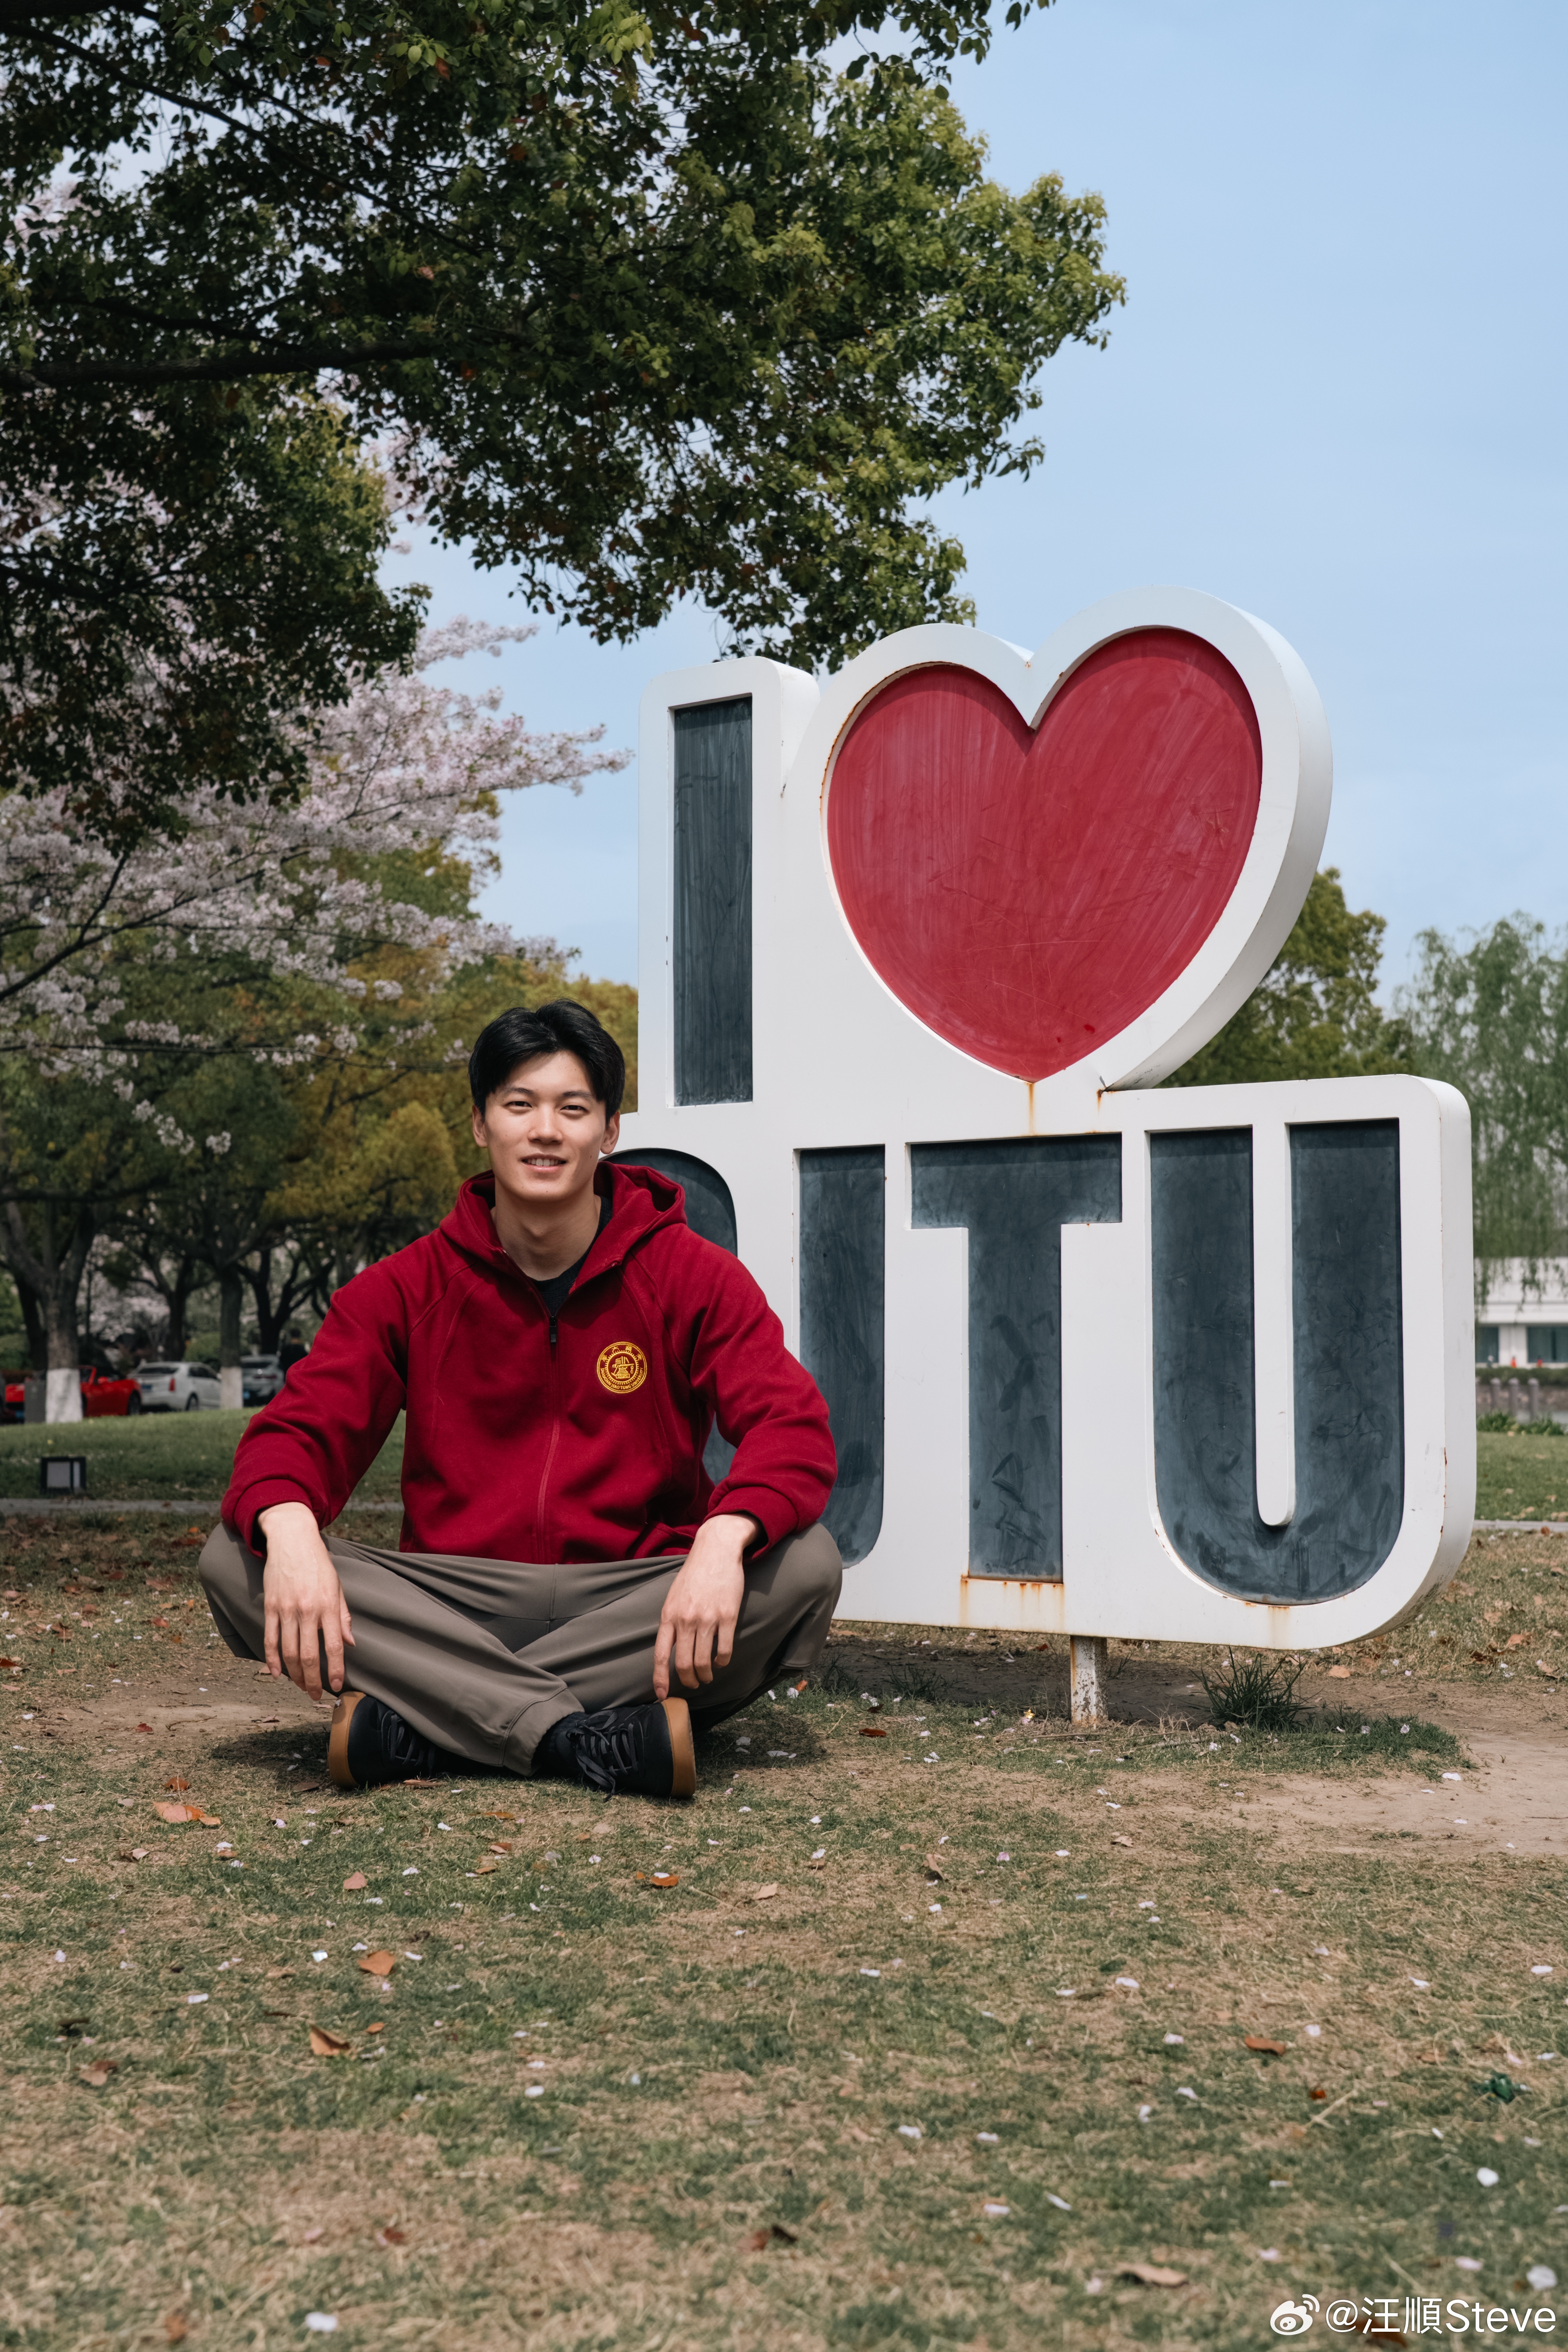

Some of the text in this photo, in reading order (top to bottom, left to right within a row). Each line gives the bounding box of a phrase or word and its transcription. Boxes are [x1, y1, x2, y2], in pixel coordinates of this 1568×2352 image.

[673, 696, 753, 1107] I
[599, 1117, 1405, 1605] JTU
[601, 1368, 611, 1385] SHANGHAI
[631, 1367, 643, 1387] UNIVERSITY
